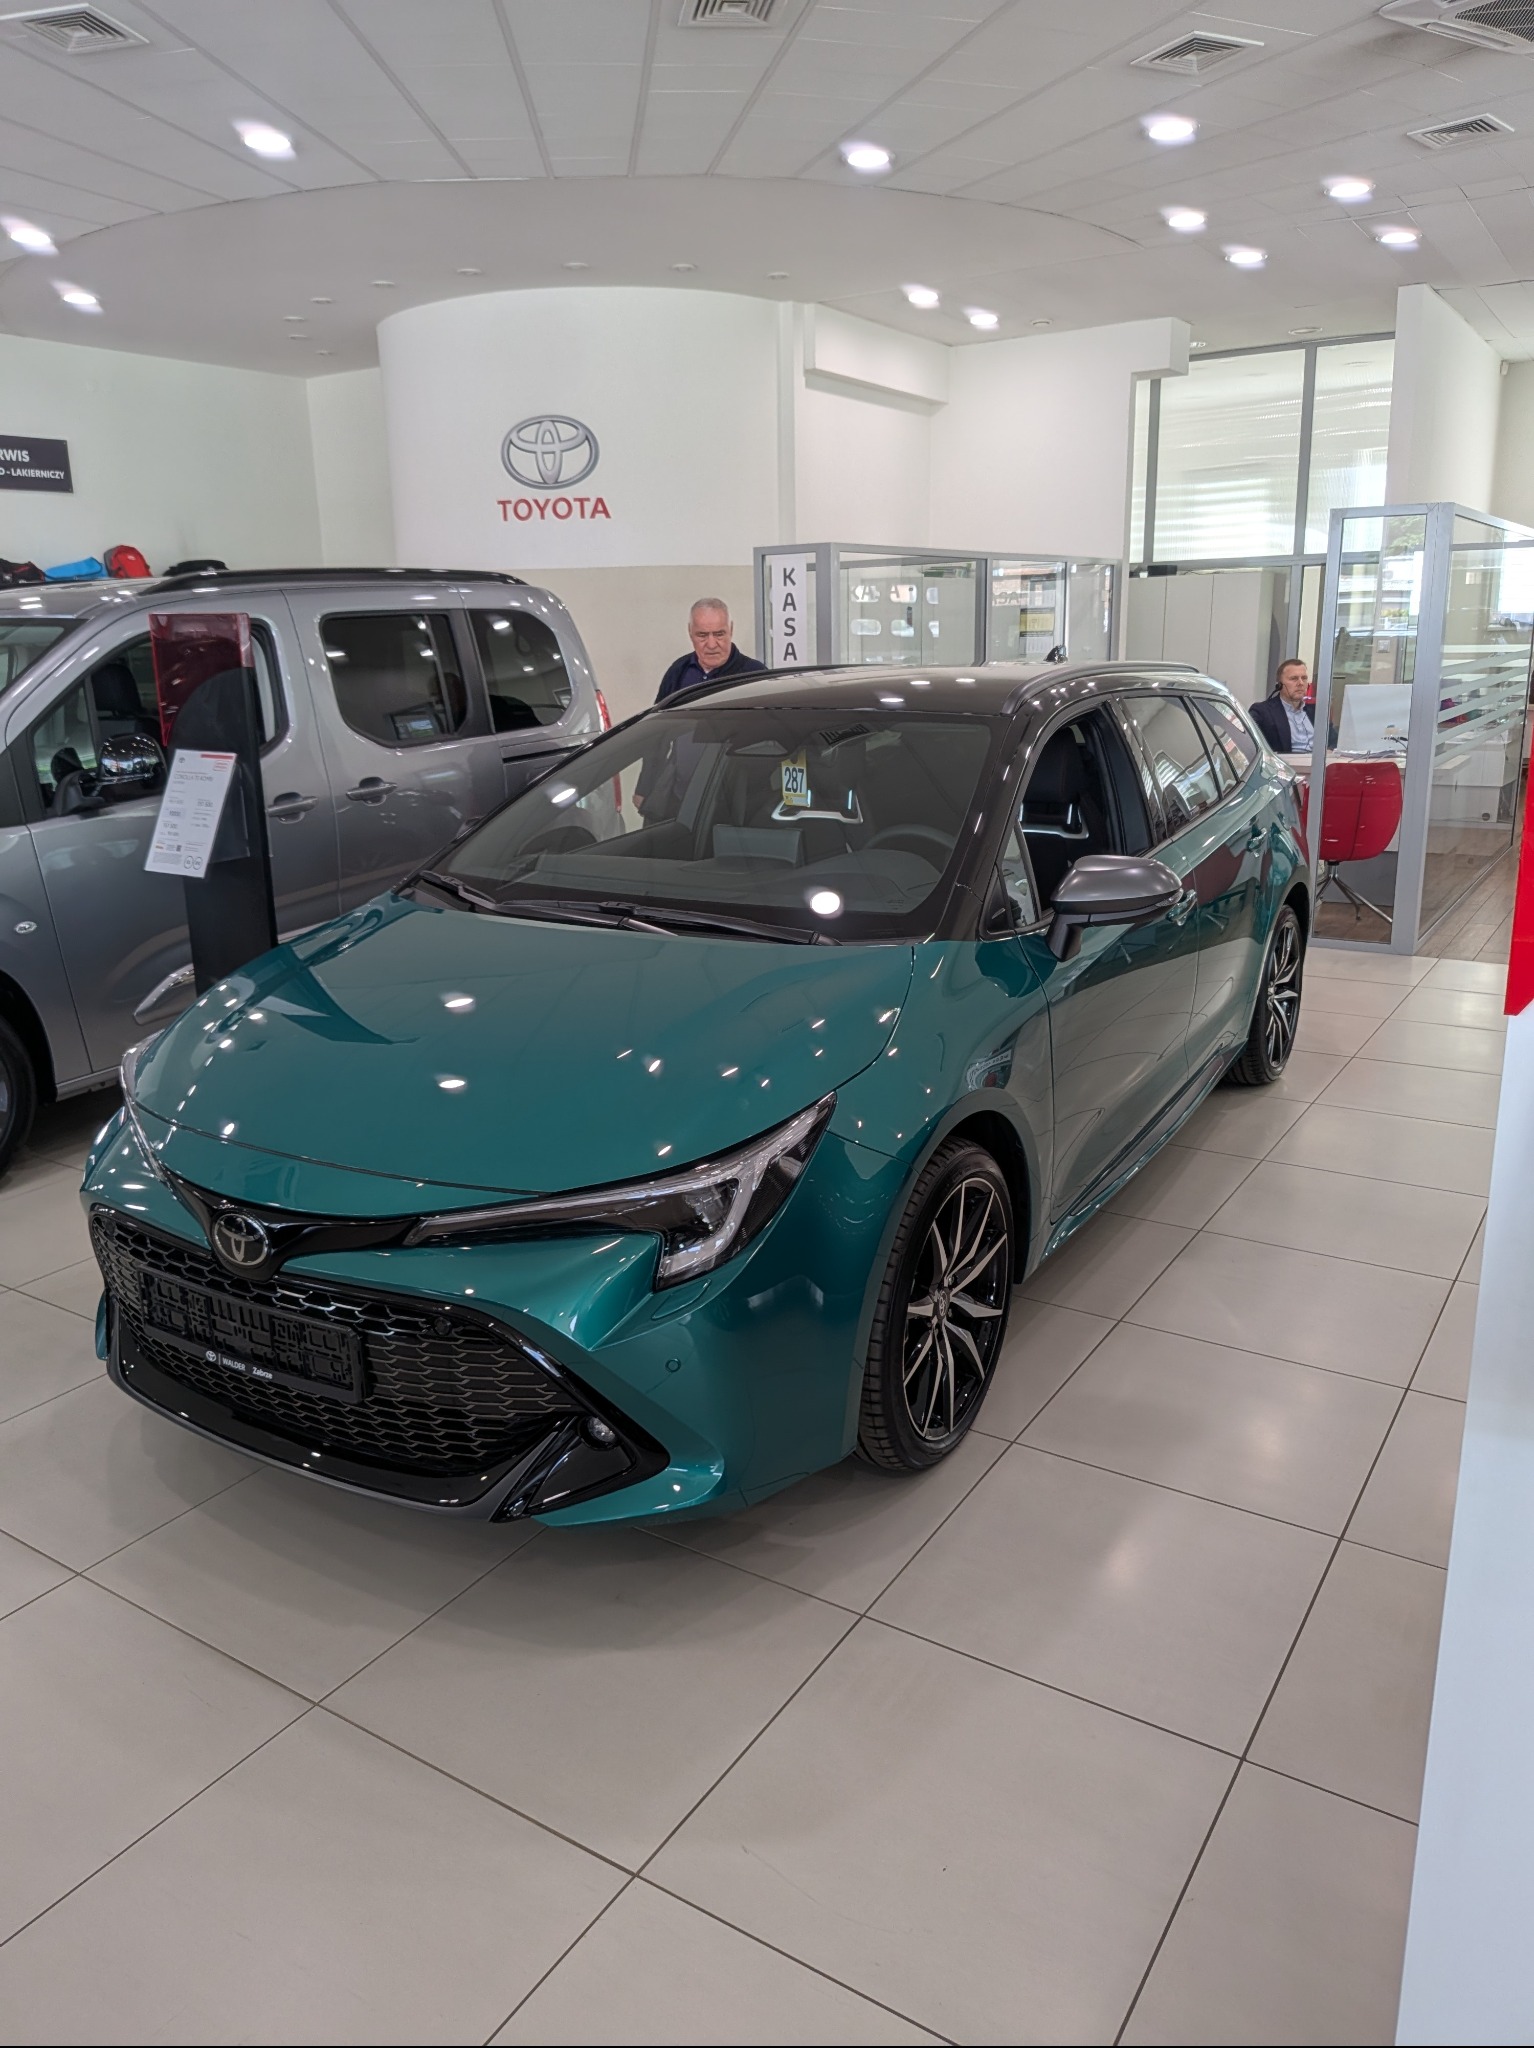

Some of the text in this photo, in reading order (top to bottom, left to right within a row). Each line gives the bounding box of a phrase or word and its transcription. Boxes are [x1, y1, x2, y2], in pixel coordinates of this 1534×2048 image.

[11, 468, 65, 479] LAKIERNICZY
[497, 497, 612, 522] TOYOTA
[782, 567, 798, 662] KASA
[784, 766, 805, 794] 287
[222, 1357, 273, 1379] WALDER Zabrze
